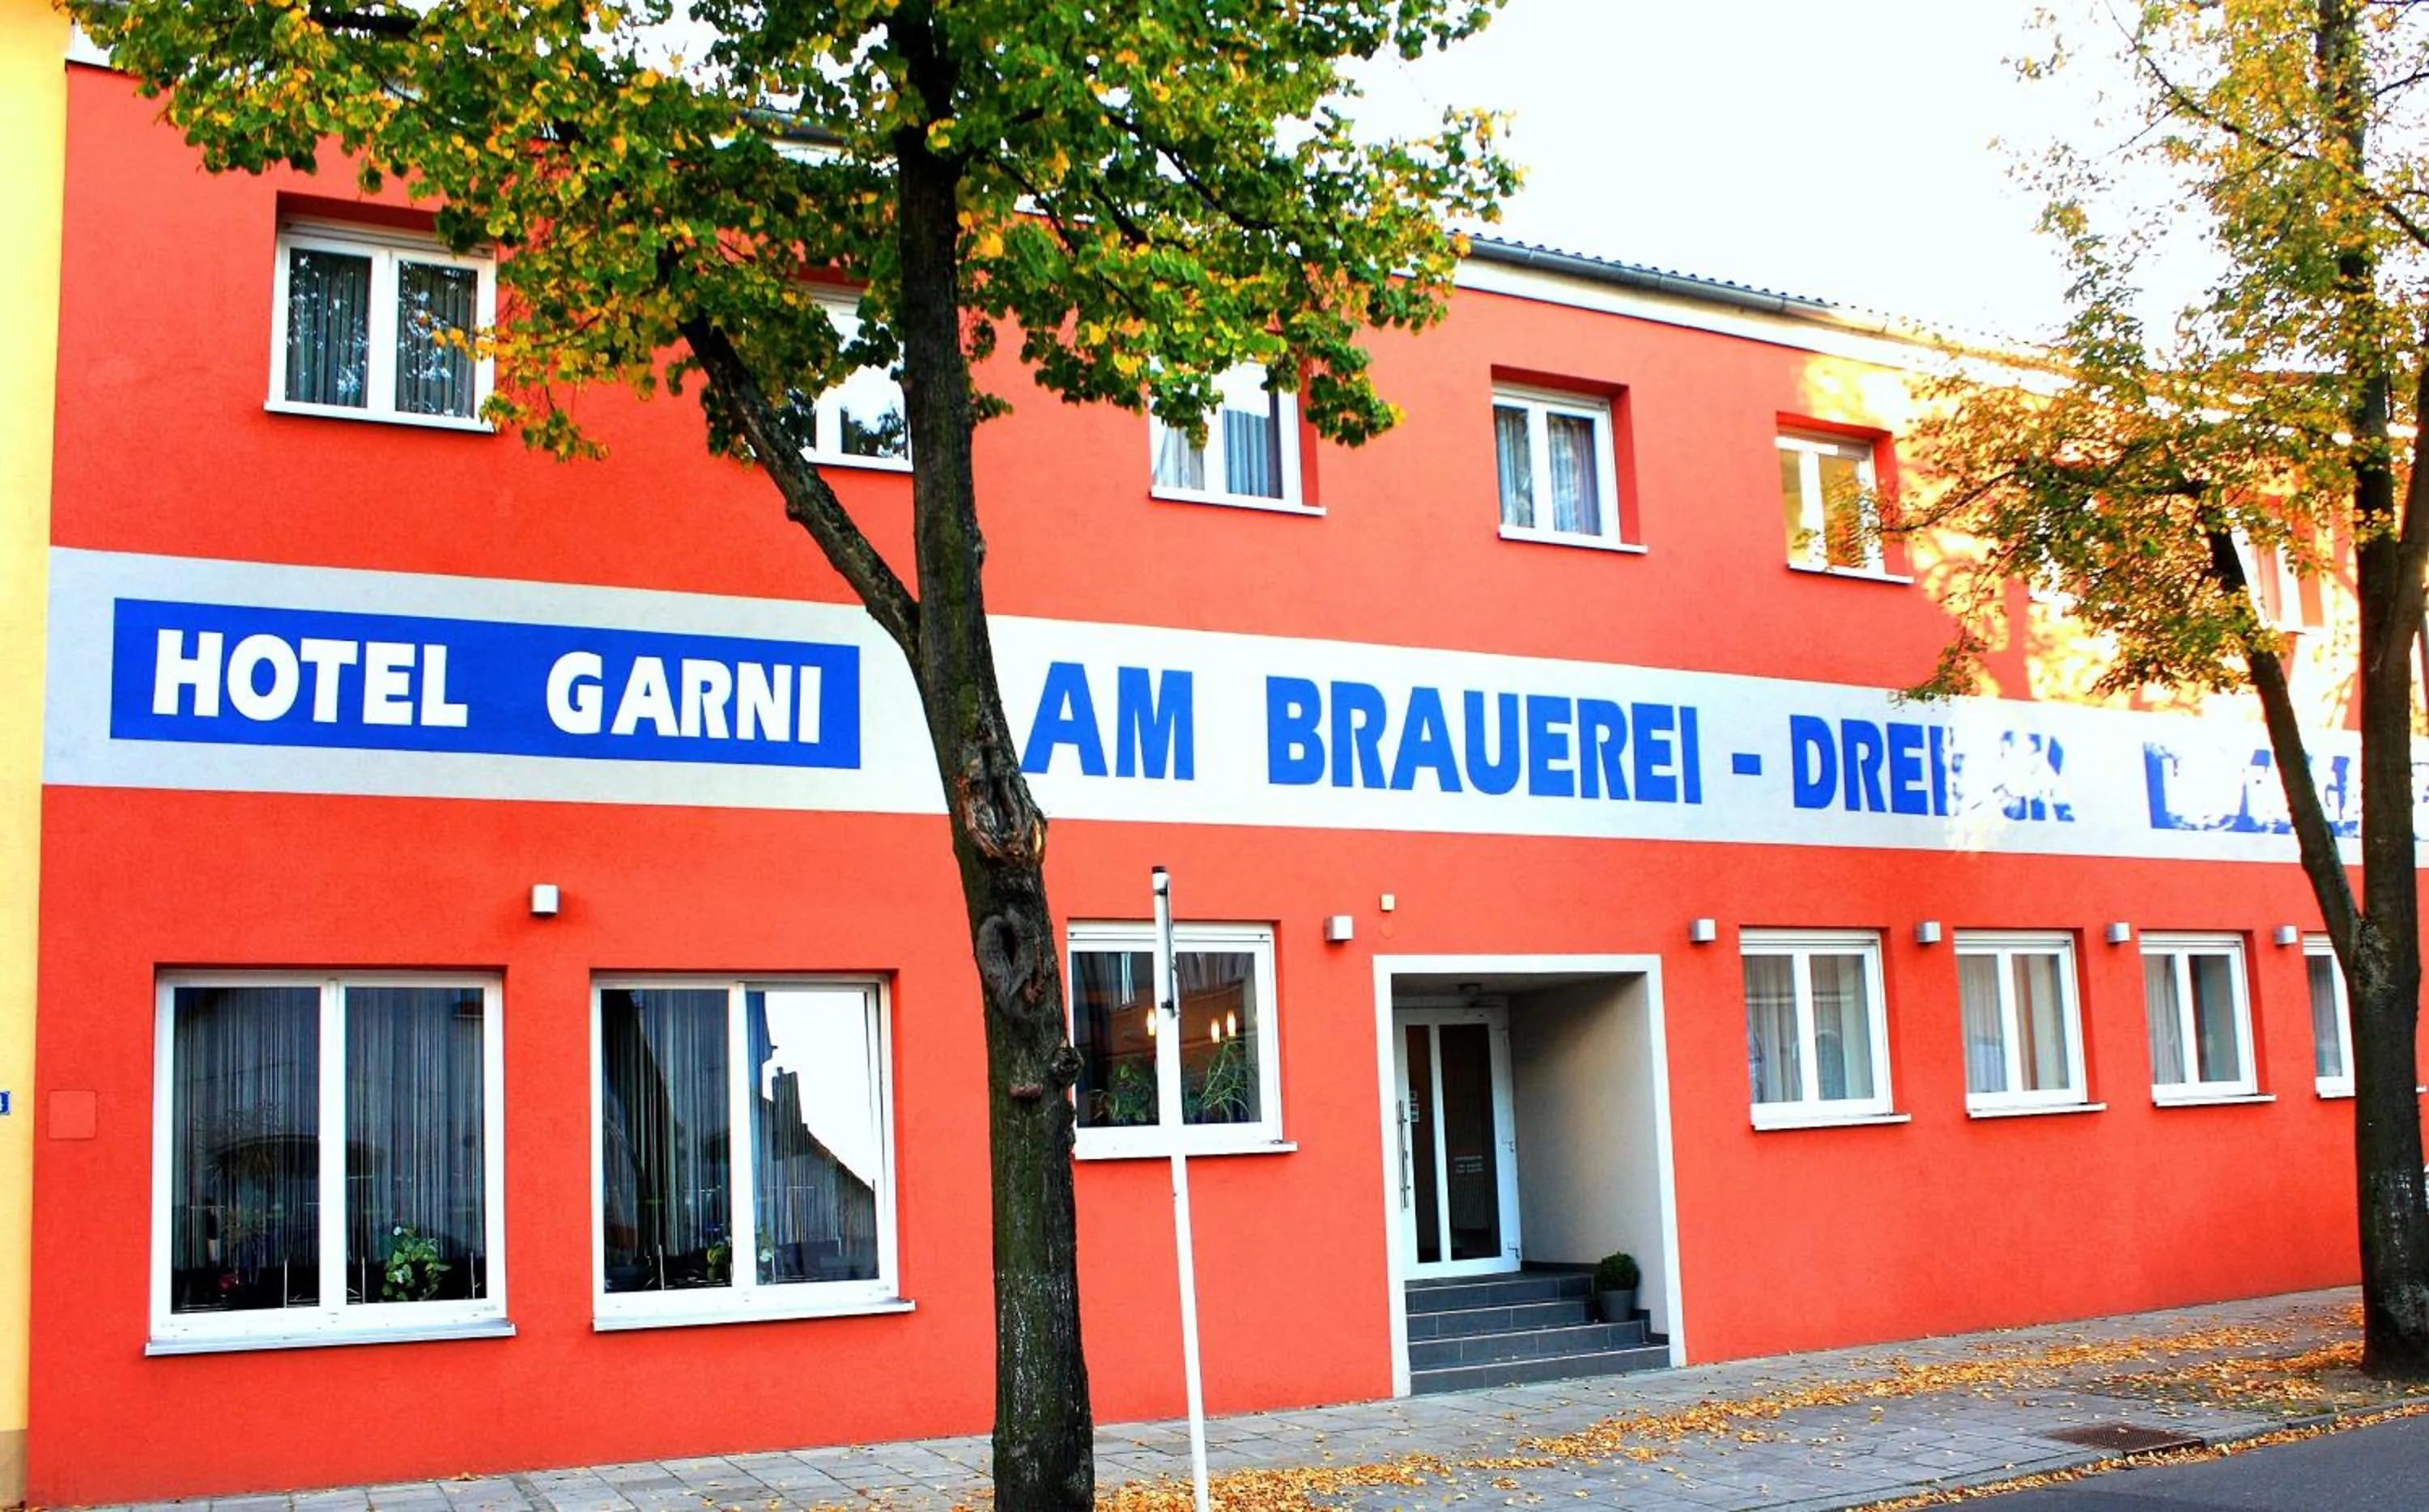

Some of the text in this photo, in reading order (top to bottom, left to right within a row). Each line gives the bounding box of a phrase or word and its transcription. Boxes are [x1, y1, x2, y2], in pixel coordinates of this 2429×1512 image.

[151, 628, 821, 744] HOTEL GARNI
[1020, 661, 1195, 781] AM
[1265, 675, 1703, 805] BRAUEREI
[1789, 714, 2076, 823] DREI
